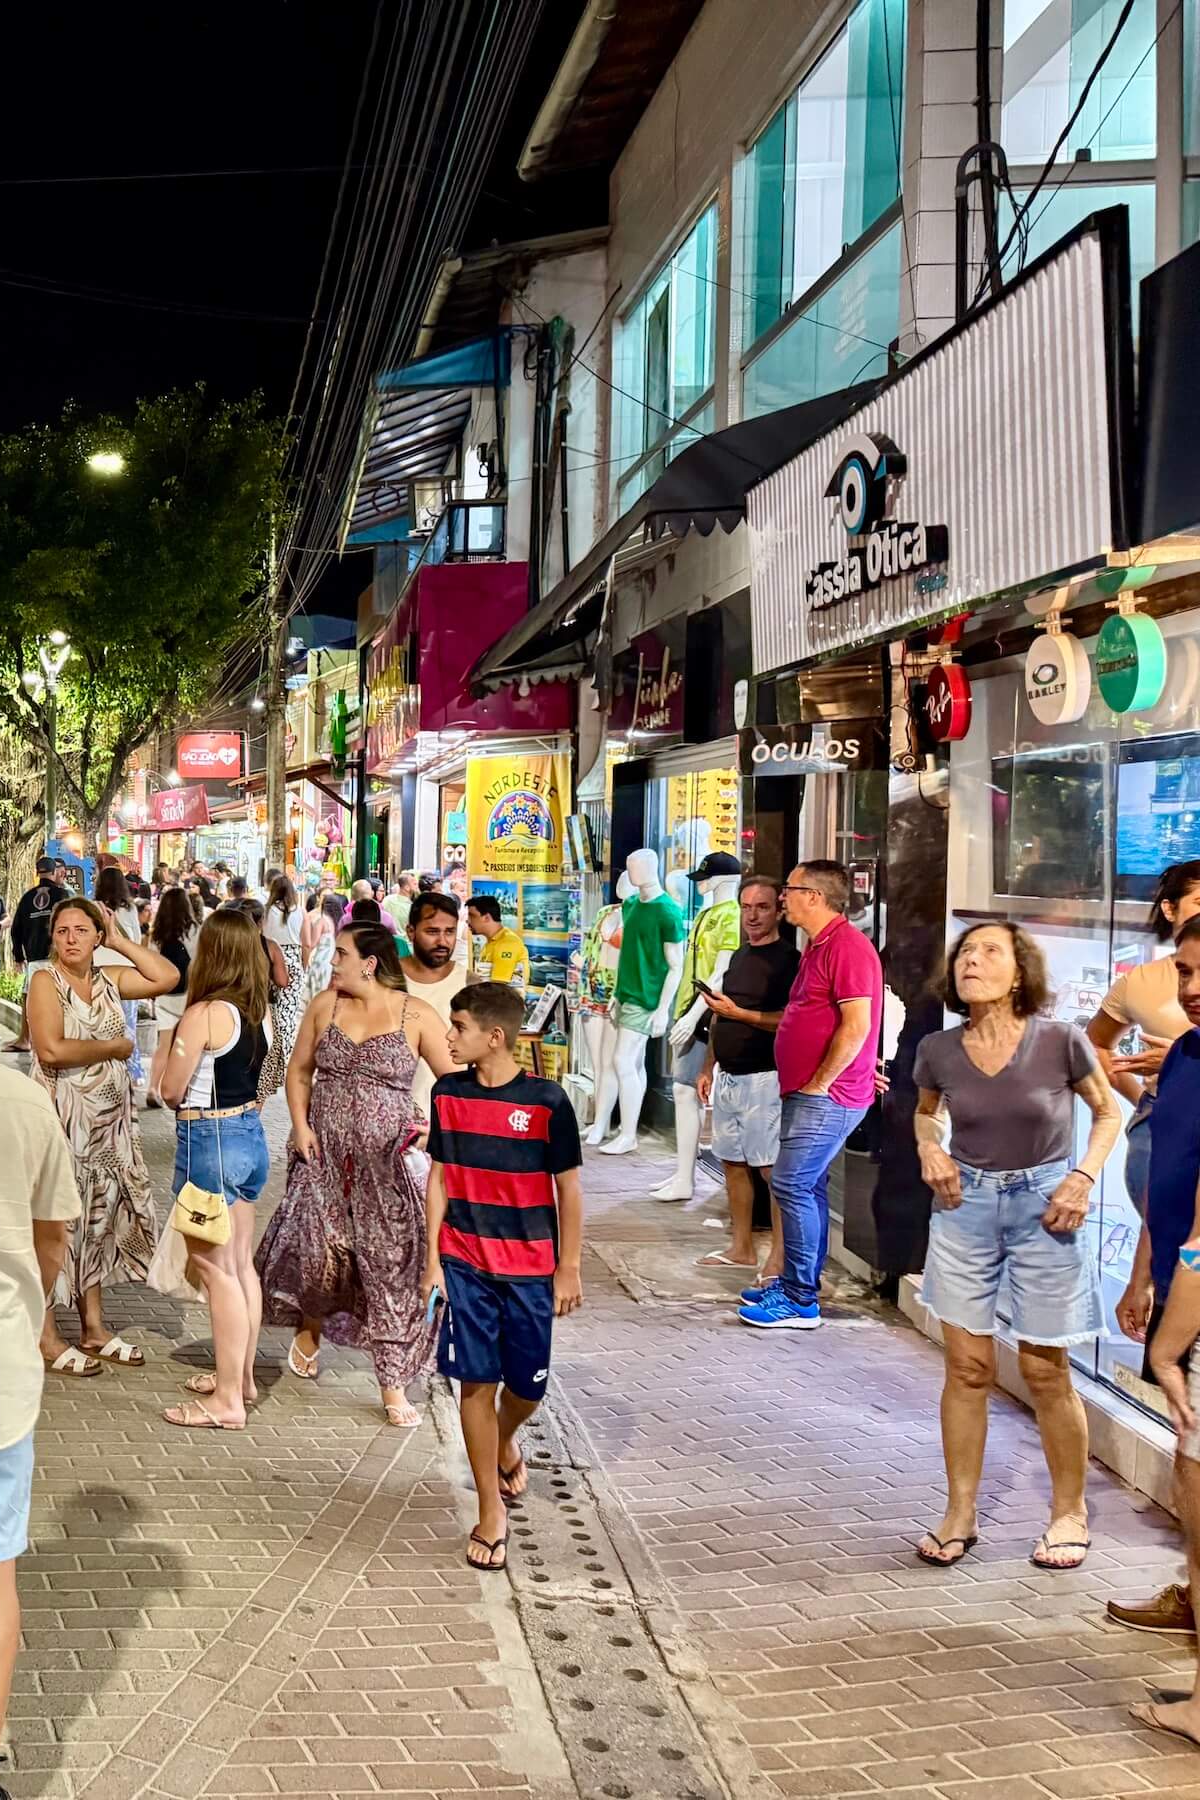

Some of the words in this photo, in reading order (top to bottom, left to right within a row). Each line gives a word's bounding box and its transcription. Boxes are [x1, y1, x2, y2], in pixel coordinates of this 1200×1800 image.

[866, 520, 927, 583] Ótica
[751, 738, 860, 763] ÓCULOS
[484, 772, 558, 805] NORDESTE
[490, 863, 515, 872] PASSEIOS
